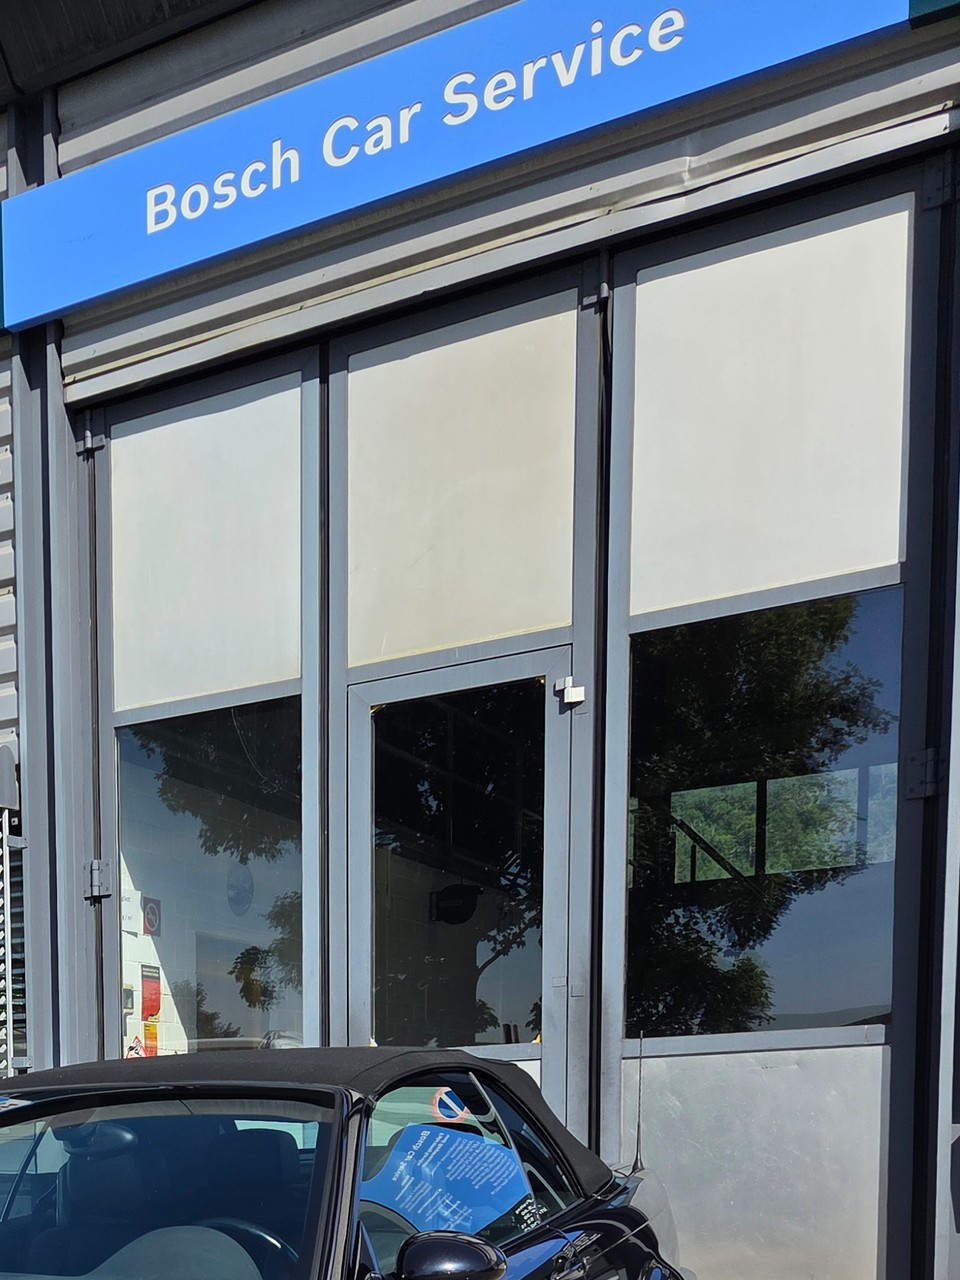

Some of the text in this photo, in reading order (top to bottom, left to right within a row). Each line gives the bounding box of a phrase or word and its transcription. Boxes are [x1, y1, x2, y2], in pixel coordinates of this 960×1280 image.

[146, 8, 687, 236] Bosch Car Service
